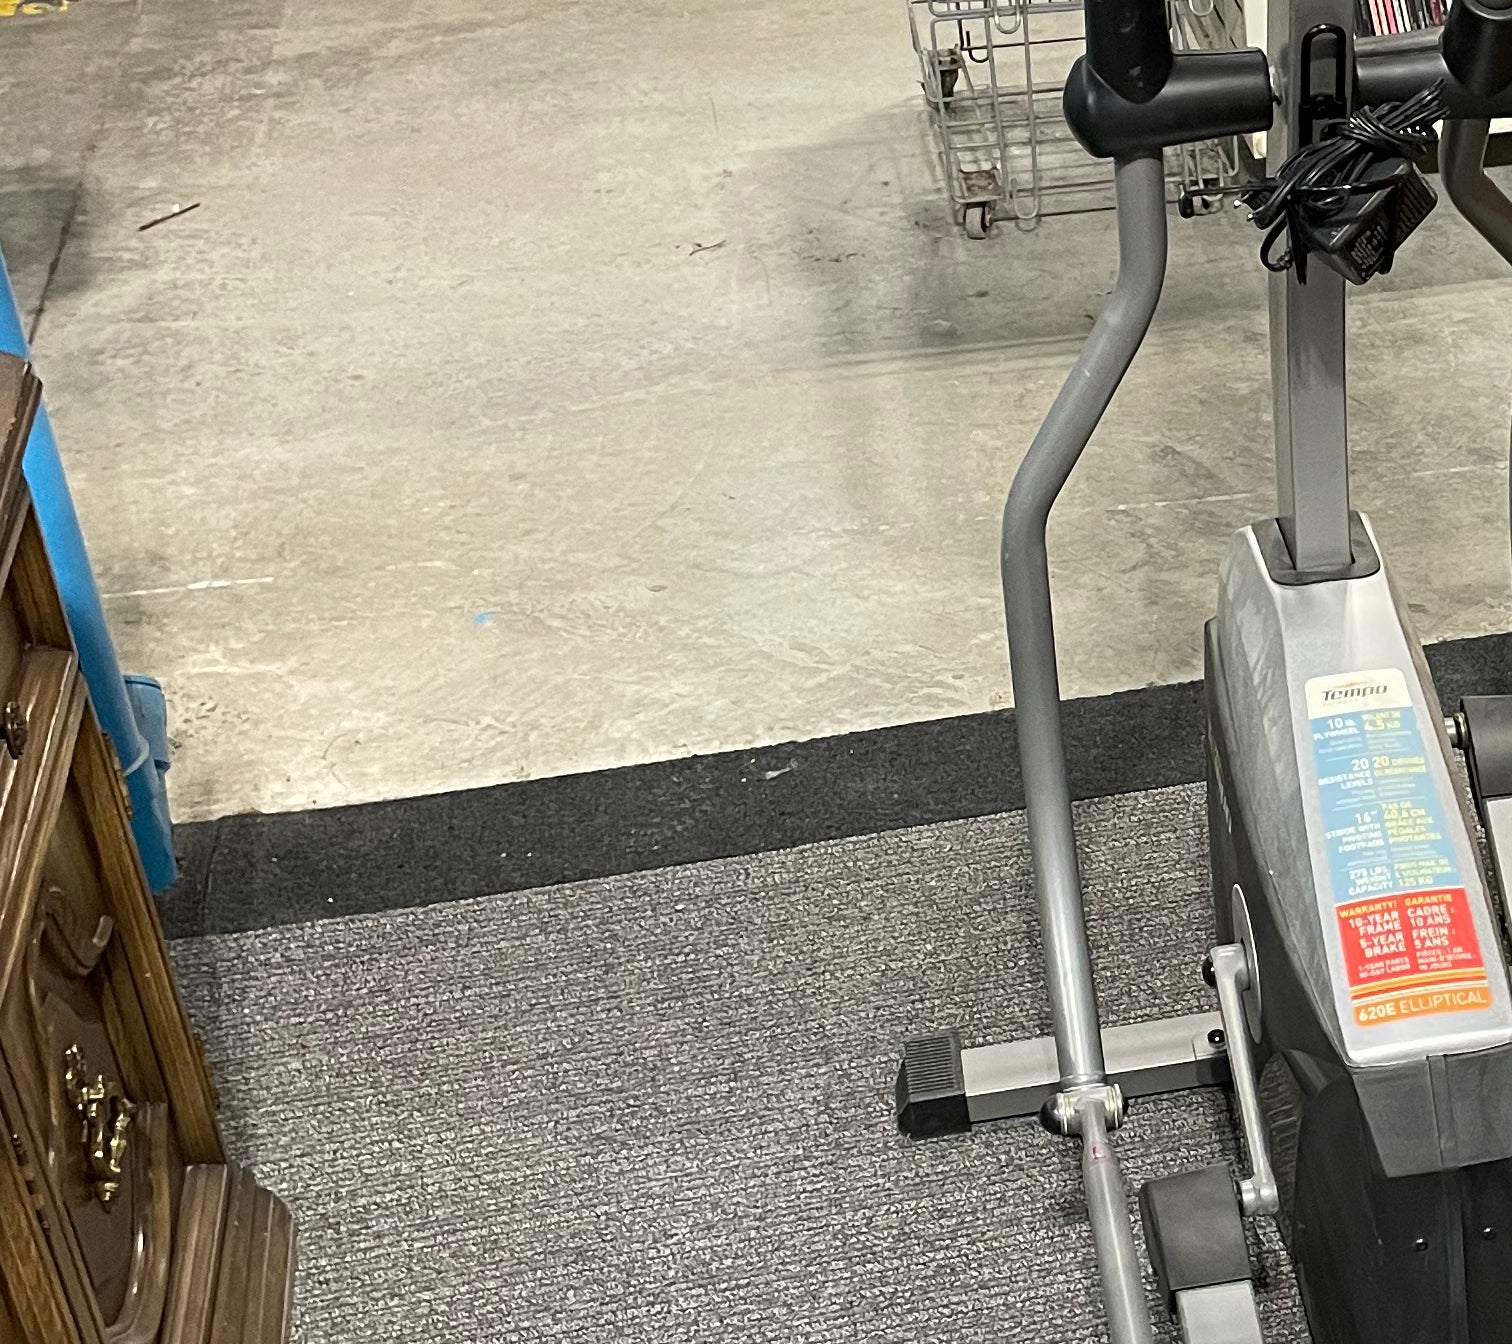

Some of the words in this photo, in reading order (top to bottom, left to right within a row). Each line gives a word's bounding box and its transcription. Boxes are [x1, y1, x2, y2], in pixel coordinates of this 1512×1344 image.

[1322, 685, 1387, 702] Tempo
[1327, 717, 1343, 730] 10
[1351, 757, 1370, 771] 20
[1371, 755, 1390, 769] 20
[1317, 770, 1371, 786] RESISTANCE
[1340, 777, 1374, 790] LEVELS
[1410, 807, 1426, 816] CM
[1348, 880, 1393, 896] CAPACITY
[1405, 894, 1452, 906] GARANTIE
[1407, 904, 1448, 918] CADRE
[1349, 910, 1400, 929] 10-YEAR
[1410, 917, 1423, 927] 10
[1426, 914, 1451, 925] ANS
[1358, 922, 1402, 937] FRAME
[1412, 926, 1449, 940] FREIN
[1359, 932, 1405, 949] 5-YEAR
[1414, 939, 1421, 949] 5
[1425, 937, 1449, 947] ANS
[1364, 943, 1407, 958] BRAKE
[1359, 1003, 1397, 1022] 620E
[1399, 990, 1487, 1014] ELLIPTICAL
